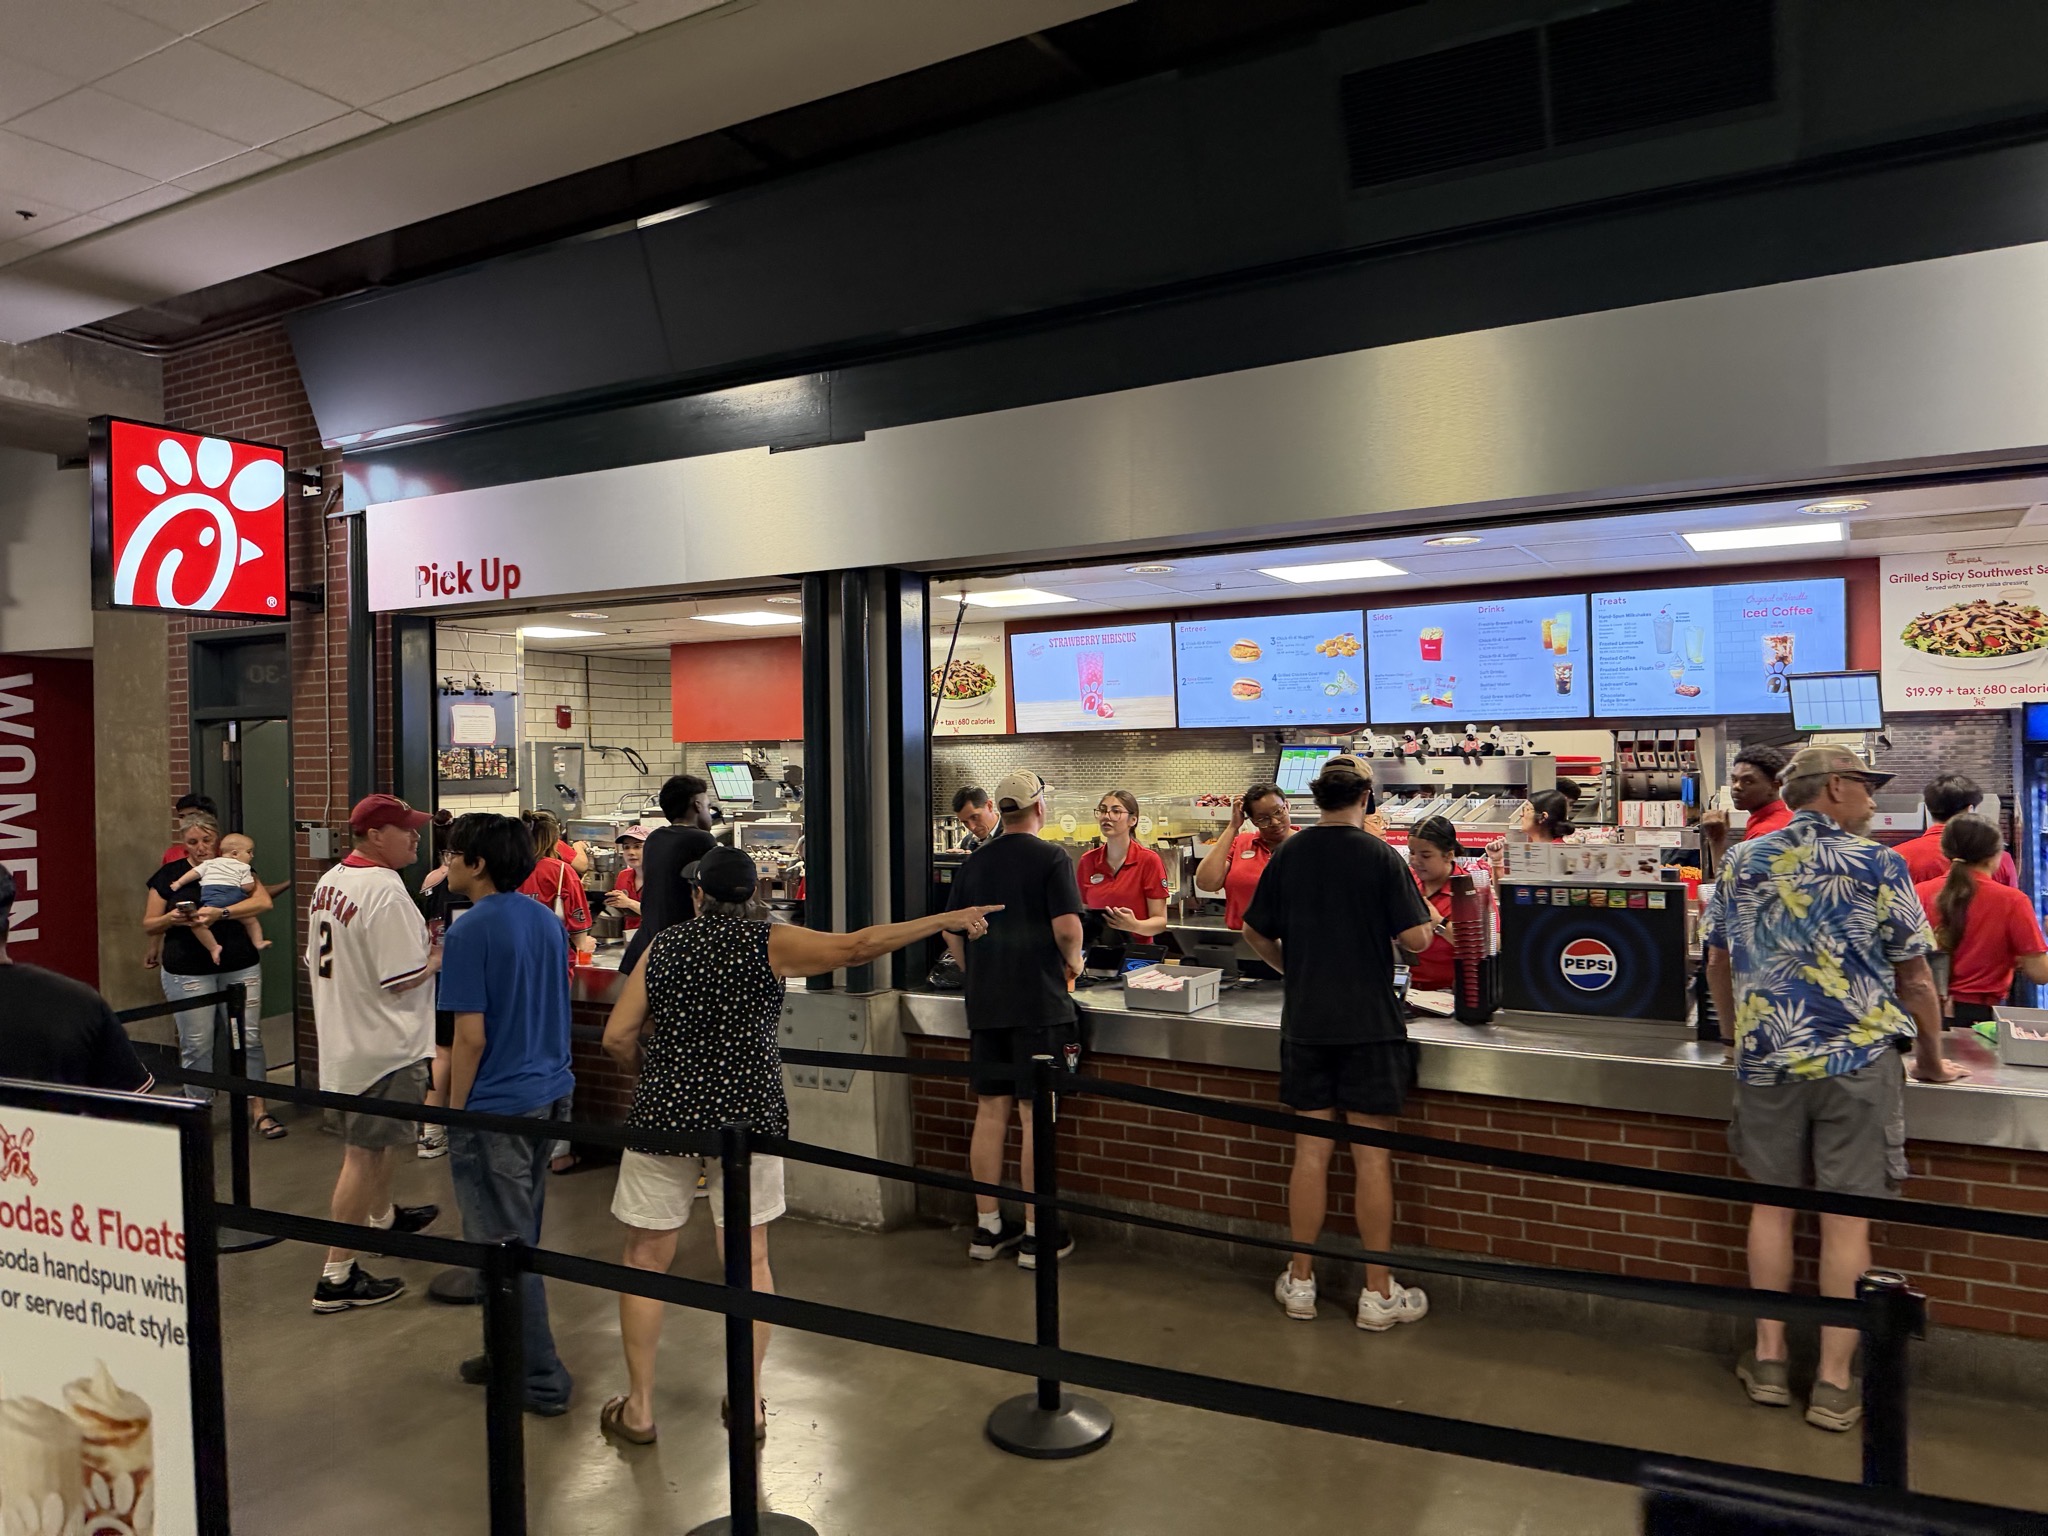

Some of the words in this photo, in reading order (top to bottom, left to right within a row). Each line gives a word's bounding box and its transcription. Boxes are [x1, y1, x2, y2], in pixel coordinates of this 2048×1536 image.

[415, 560, 473, 598] Pick
[481, 557, 521, 599] Up
[1889, 572, 1929, 584] Grilled
[1931, 570, 1965, 582] Spicy
[1967, 565, 2033, 579] Southwest
[1598, 597, 1627, 606] Treats
[1478, 605, 1505, 613] Drinks
[1743, 608, 1768, 618] Iced
[1772, 606, 1813, 617] Coffee
[1372, 613, 1393, 621] Sides
[1180, 625, 1207, 633] Entrees
[1049, 634, 1100, 648] STRAWBERRY
[1102, 632, 1137, 645] HIBISCUS
[1180, 642, 1186, 651] 1
[1270, 636, 1276, 646] 3
[1181, 677, 1187, 686] 2
[1271, 673, 1277, 682] 4
[1905, 686, 1943, 698] $19.99
[1957, 686, 1976, 695] tax
[1983, 684, 2007, 695] 680
[319, 921, 333, 979] 2
[1564, 957, 1613, 971] PEPSI
[71, 1204, 92, 1244] &
[98, 1208, 187, 1262] Floats
[44, 1251, 137, 1295] handspun
[141, 1274, 184, 1305] with
[1, 1289, 21, 1308] or
[25, 1295, 87, 1324] served
[91, 1303, 136, 1335] float
